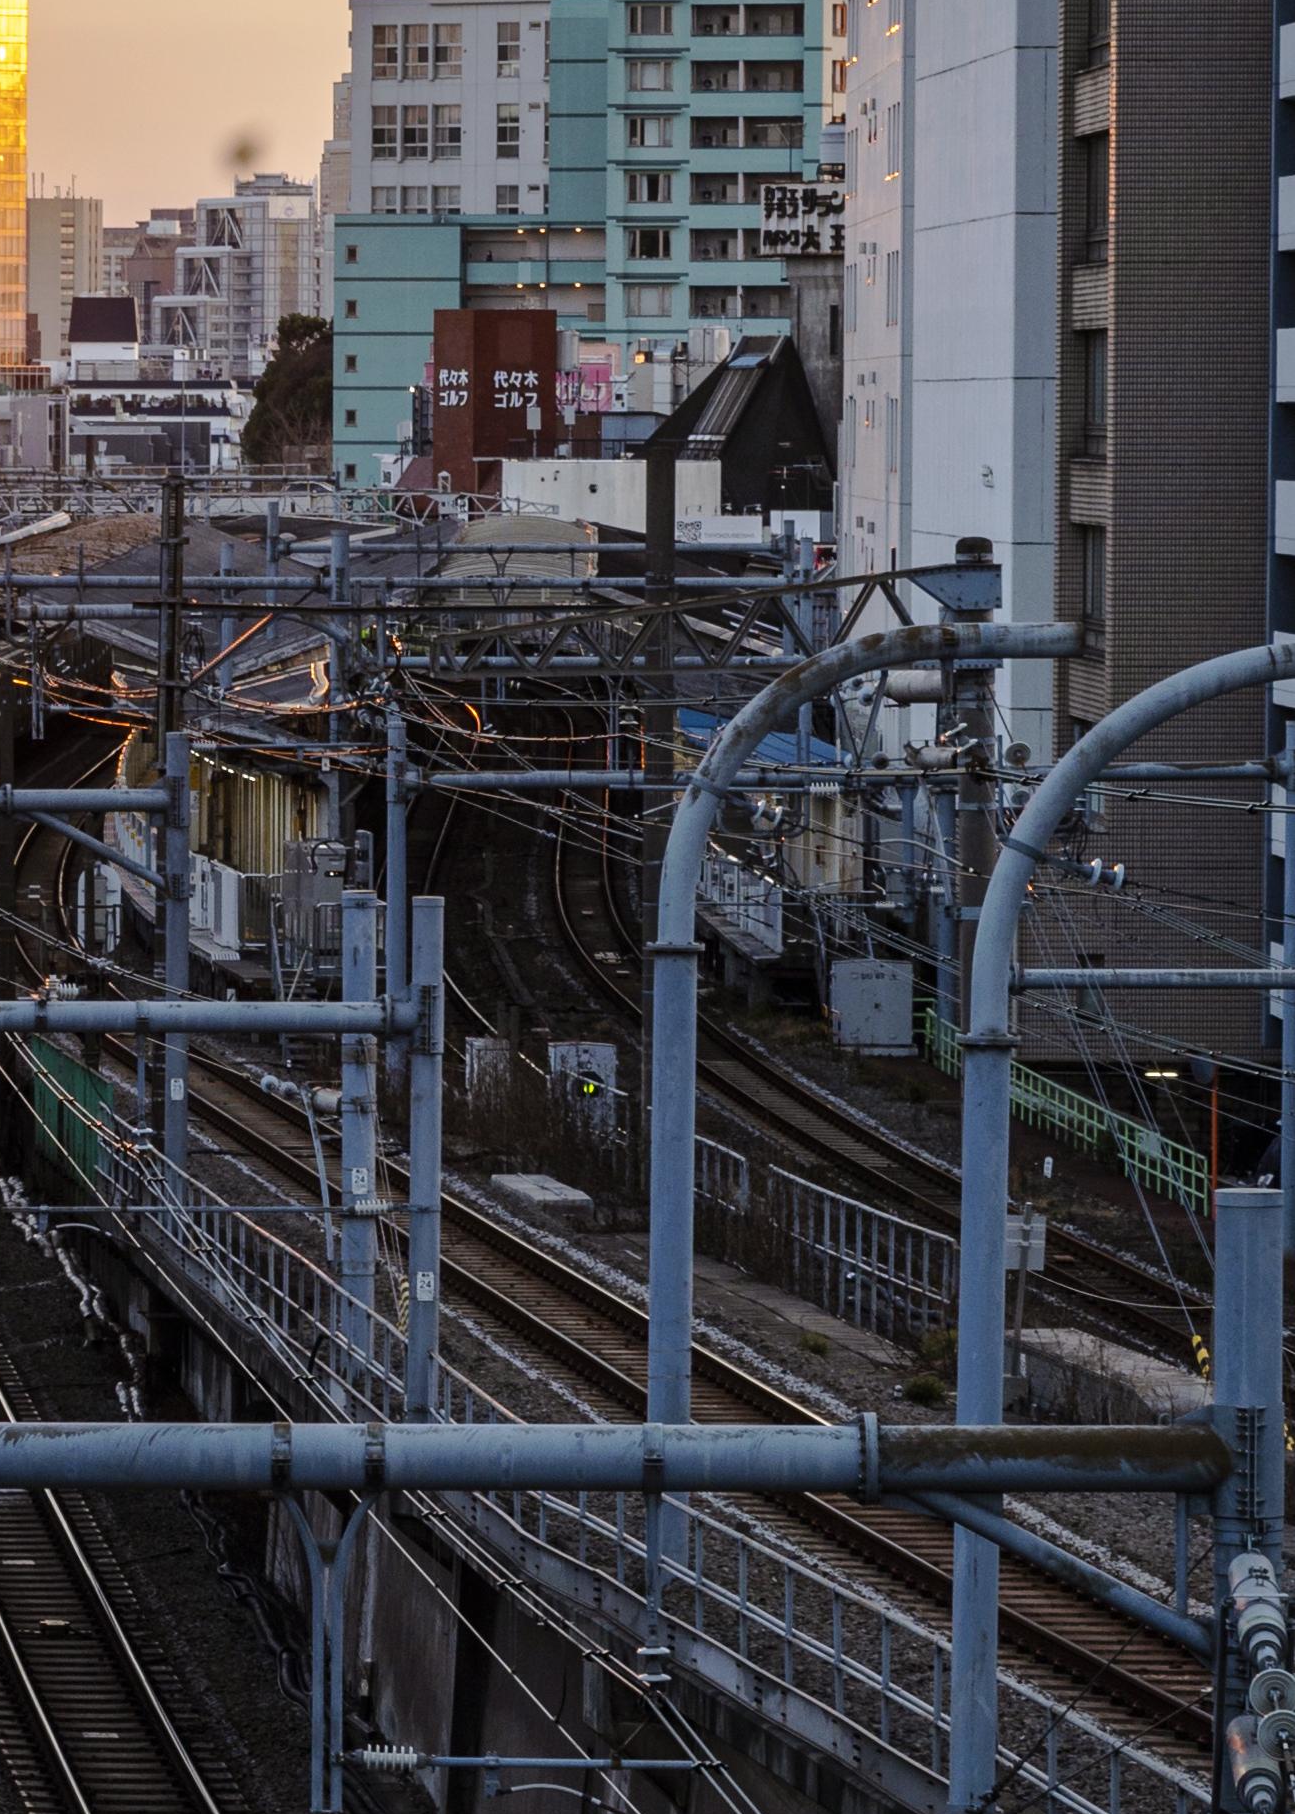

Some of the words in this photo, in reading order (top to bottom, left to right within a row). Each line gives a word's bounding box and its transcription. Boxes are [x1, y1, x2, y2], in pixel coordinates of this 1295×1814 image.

[439, 369, 469, 386] 代々木
[494, 370, 538, 388] 代々木
[439, 390, 468, 406] ゴルフ
[494, 392, 538, 408] ゴルフ
[354, 1175, 365, 1184] 24
[419, 1280, 432, 1289] 24
